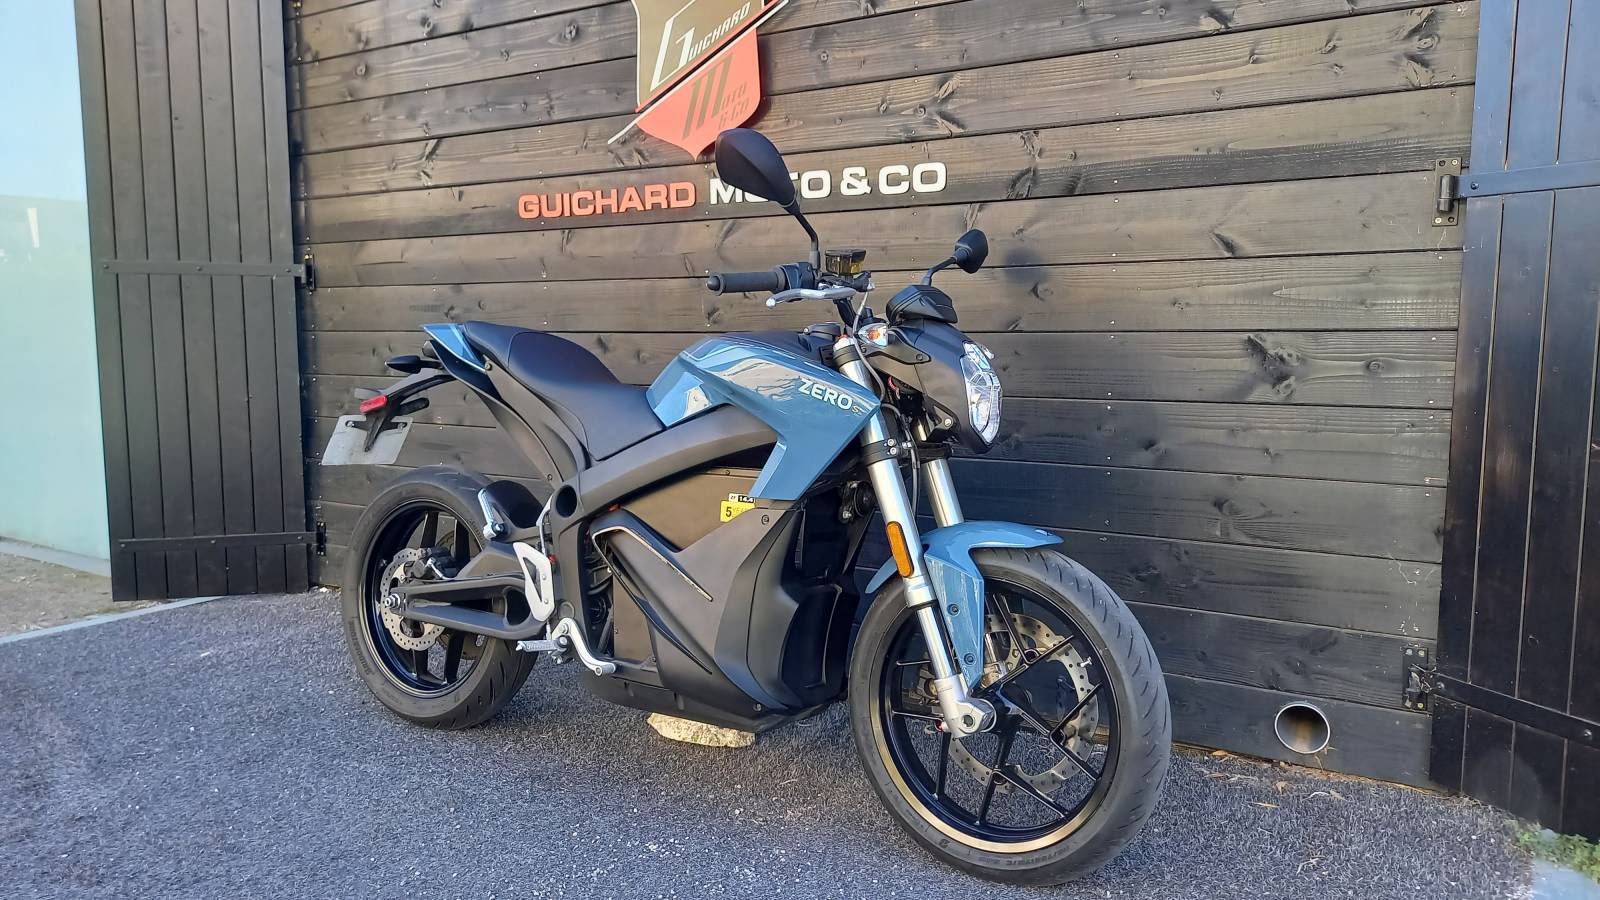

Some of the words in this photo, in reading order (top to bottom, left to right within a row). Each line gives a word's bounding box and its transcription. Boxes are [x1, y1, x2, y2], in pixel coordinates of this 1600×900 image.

[518, 181, 697, 219] GUICHARD
[840, 166, 872, 196] &
[878, 162, 947, 195] CO
[798, 377, 853, 410] ZERO
[725, 506, 733, 518] 5
